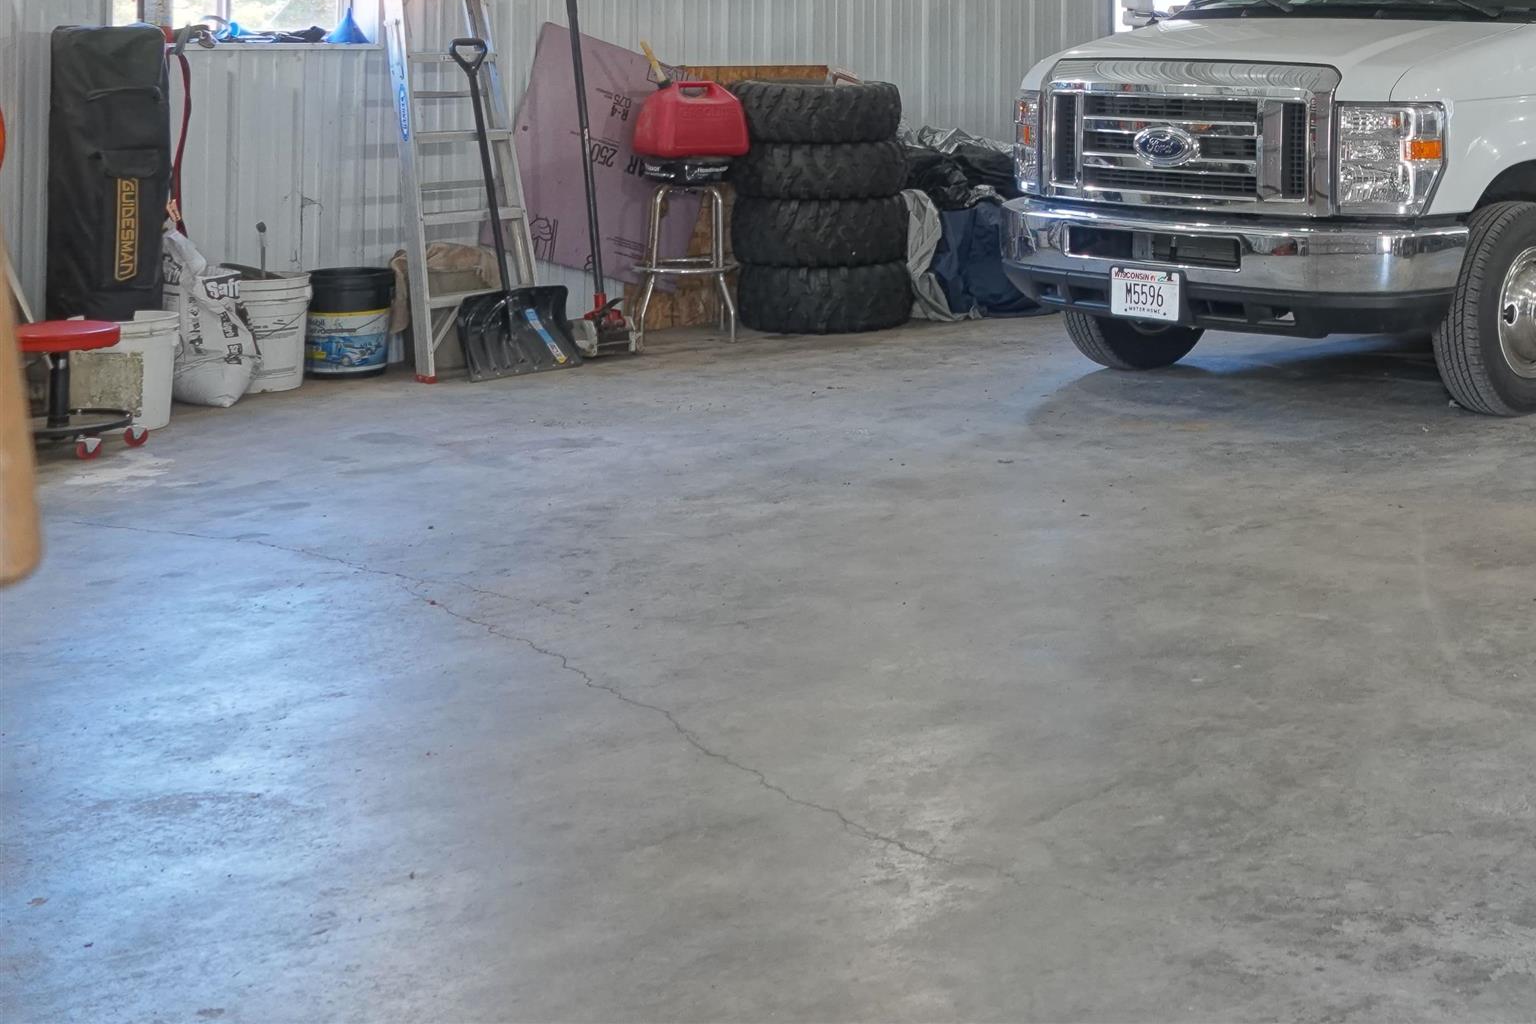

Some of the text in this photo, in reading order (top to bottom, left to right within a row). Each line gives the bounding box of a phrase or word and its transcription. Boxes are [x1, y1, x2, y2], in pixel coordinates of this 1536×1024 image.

[610, 104, 629, 121] R-4
[1147, 136, 1173, 154] Ford
[120, 180, 135, 275] GUIDESMAN
[1114, 270, 1150, 281] WISCONSIN
[1125, 282, 1164, 307] M5596
